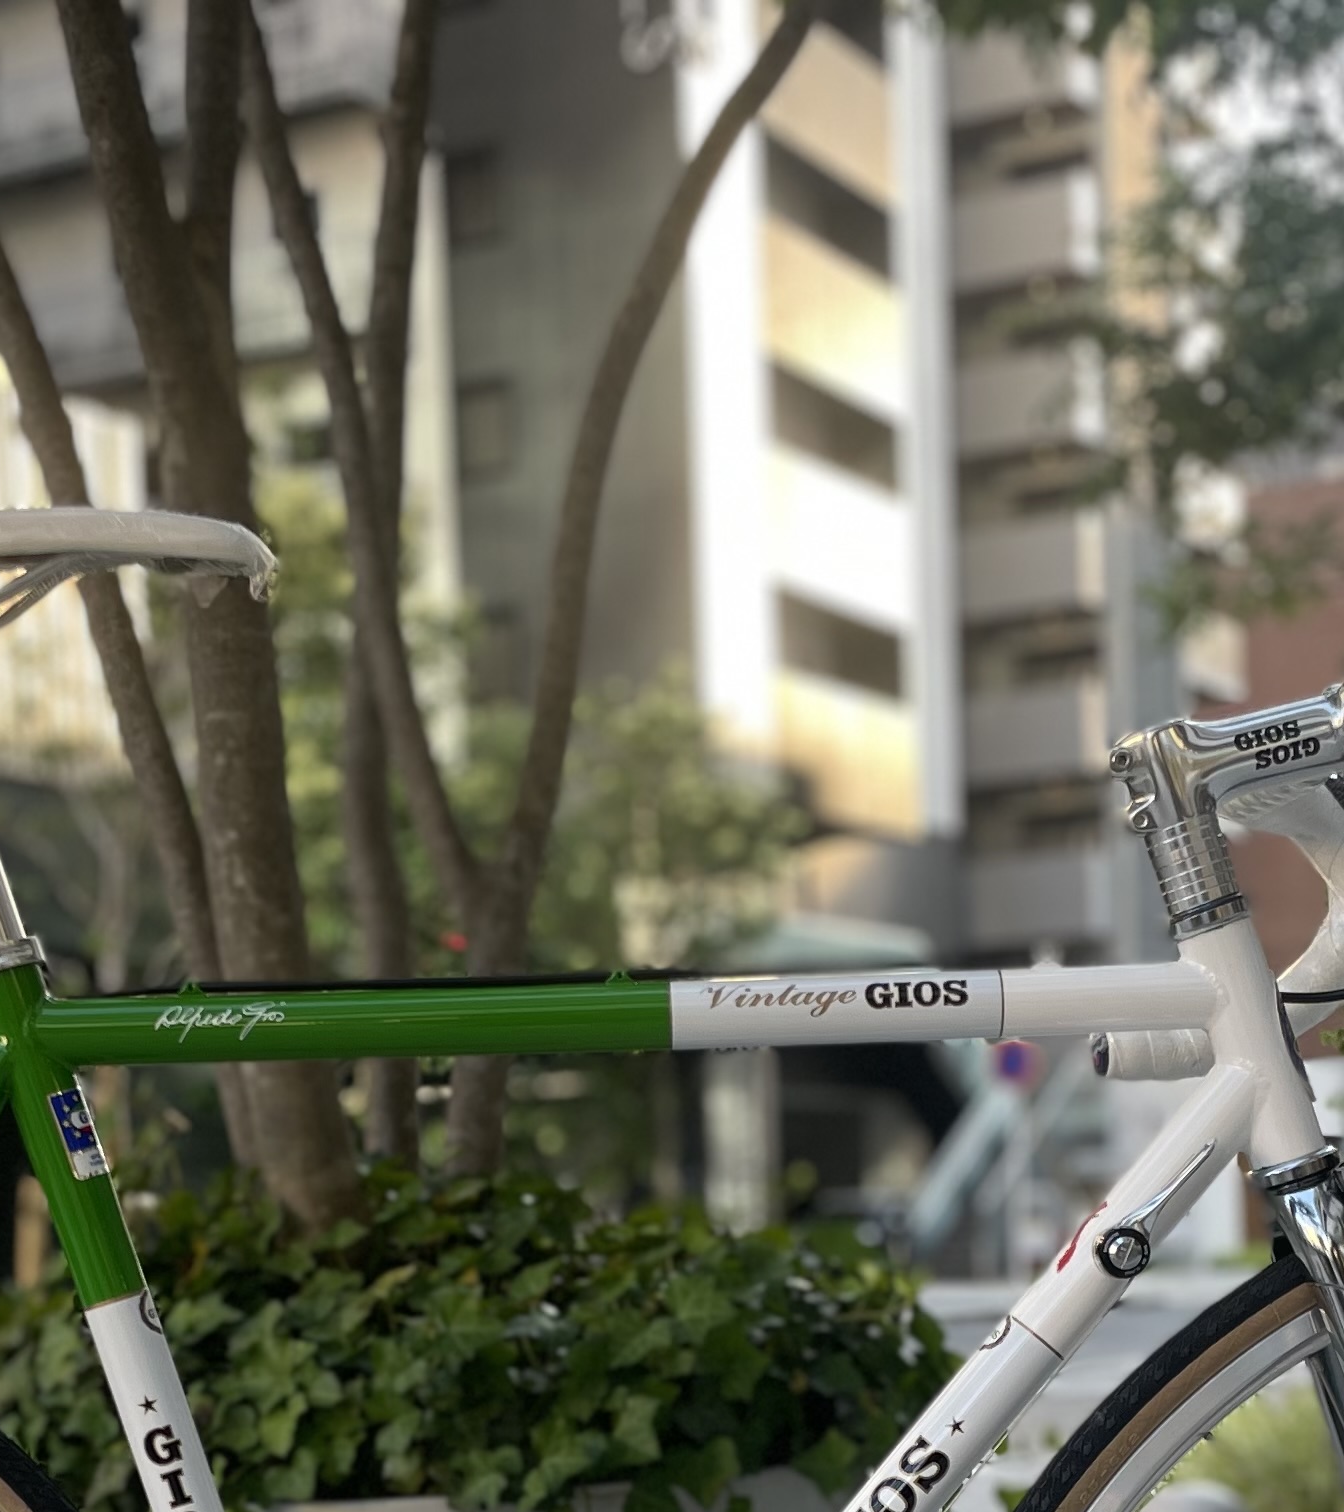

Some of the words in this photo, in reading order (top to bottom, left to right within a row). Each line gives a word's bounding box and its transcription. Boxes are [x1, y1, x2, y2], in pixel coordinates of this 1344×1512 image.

[1234, 720, 1301, 751] GIOS
[1255, 737, 1321, 770] GIOS
[701, 983, 857, 1017] Vintage
[864, 979, 969, 1010] GIOS
